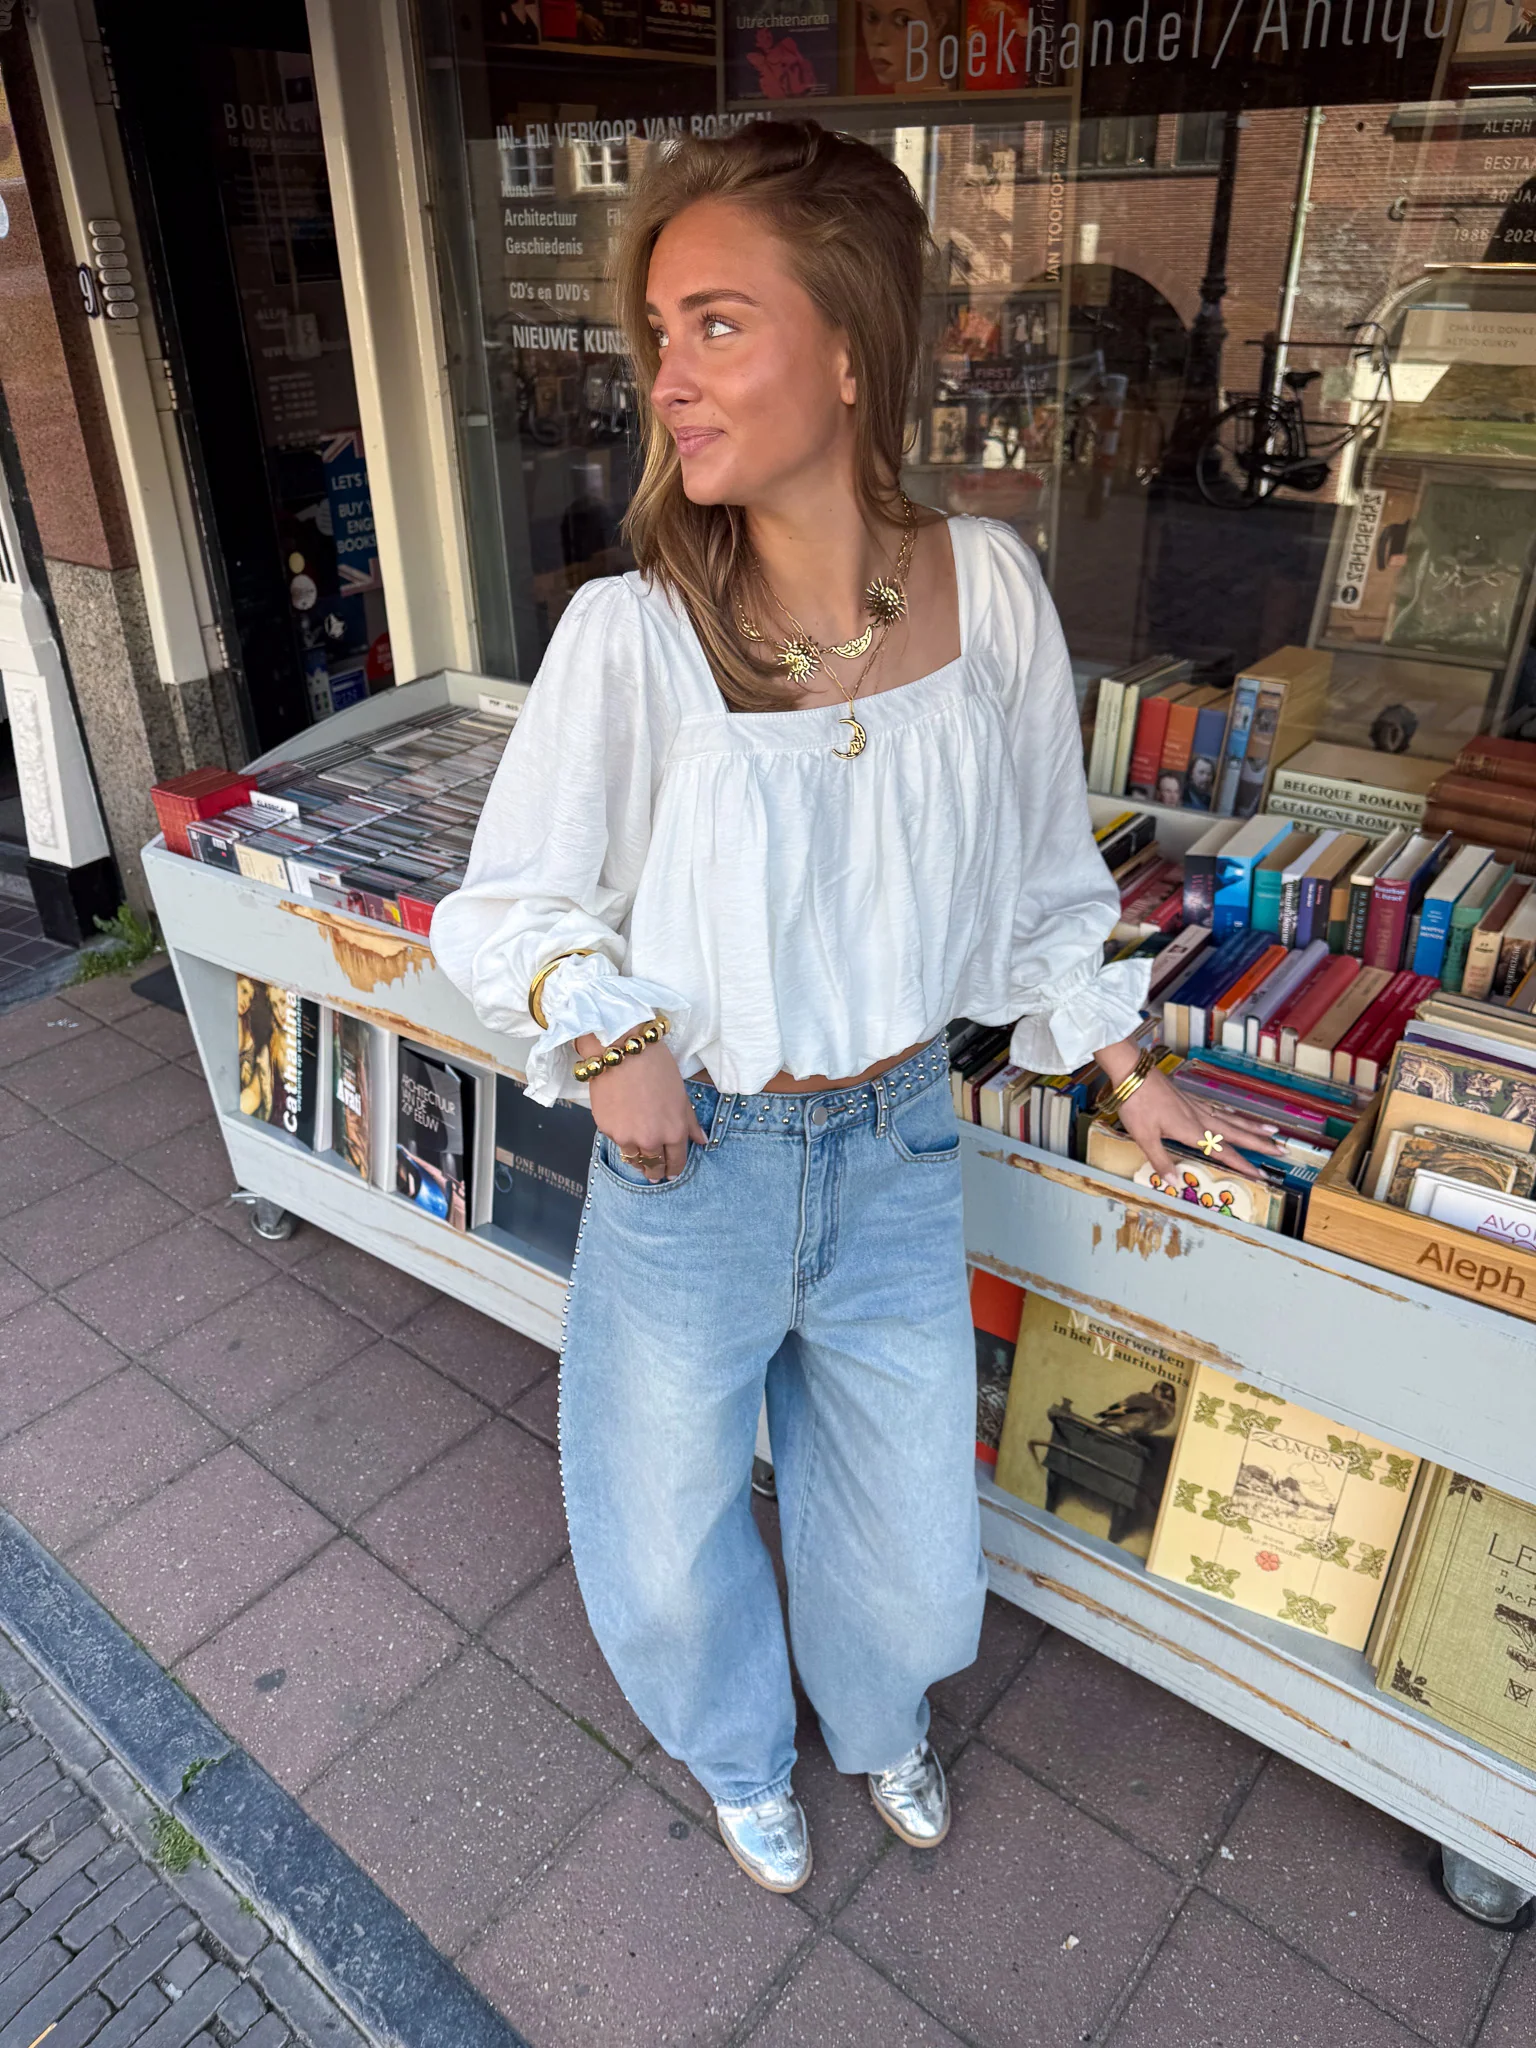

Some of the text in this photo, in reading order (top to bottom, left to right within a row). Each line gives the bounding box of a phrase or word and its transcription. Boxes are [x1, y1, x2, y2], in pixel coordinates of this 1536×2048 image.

[680, 2, 690, 15] 3
[690, 3, 712, 18] MEI
[736, 12, 829, 30] Utrechtenaren
[222, 103, 317, 133] BOEKEN
[526, 123, 550, 149] EN
[555, 119, 637, 148] VERKOOP
[642, 116, 683, 141] VAN
[1482, 119, 1533, 134] ALEPH
[504, 208, 577, 226] Architectuur
[1045, 171, 1066, 283] JAN TOOROP
[505, 237, 583, 255] Geschiedenis
[78, 270, 94, 314] 9
[509, 282, 590, 301] CD's en DVD's
[512, 325, 578, 352] NIEUWE
[338, 500, 364, 518] BUY
[1270, 798, 1354, 825] CATALOGNE
[1283, 779, 1422, 815] BELGIQUE ROMANE
[282, 991, 298, 1133] Catharina
[415, 1097, 427, 1113] DE
[413, 1108, 440, 1133] EEUW
[514, 1155, 584, 1194] ONE HUNDRED
[1416, 1241, 1526, 1299] Aleph
[1066, 1308, 1186, 1370] Meesterwerken
[1052, 1320, 1190, 1389] in het Mauritshuis
[1251, 1431, 1345, 1472] ZOMER
[1488, 1532, 1536, 1576] LE
